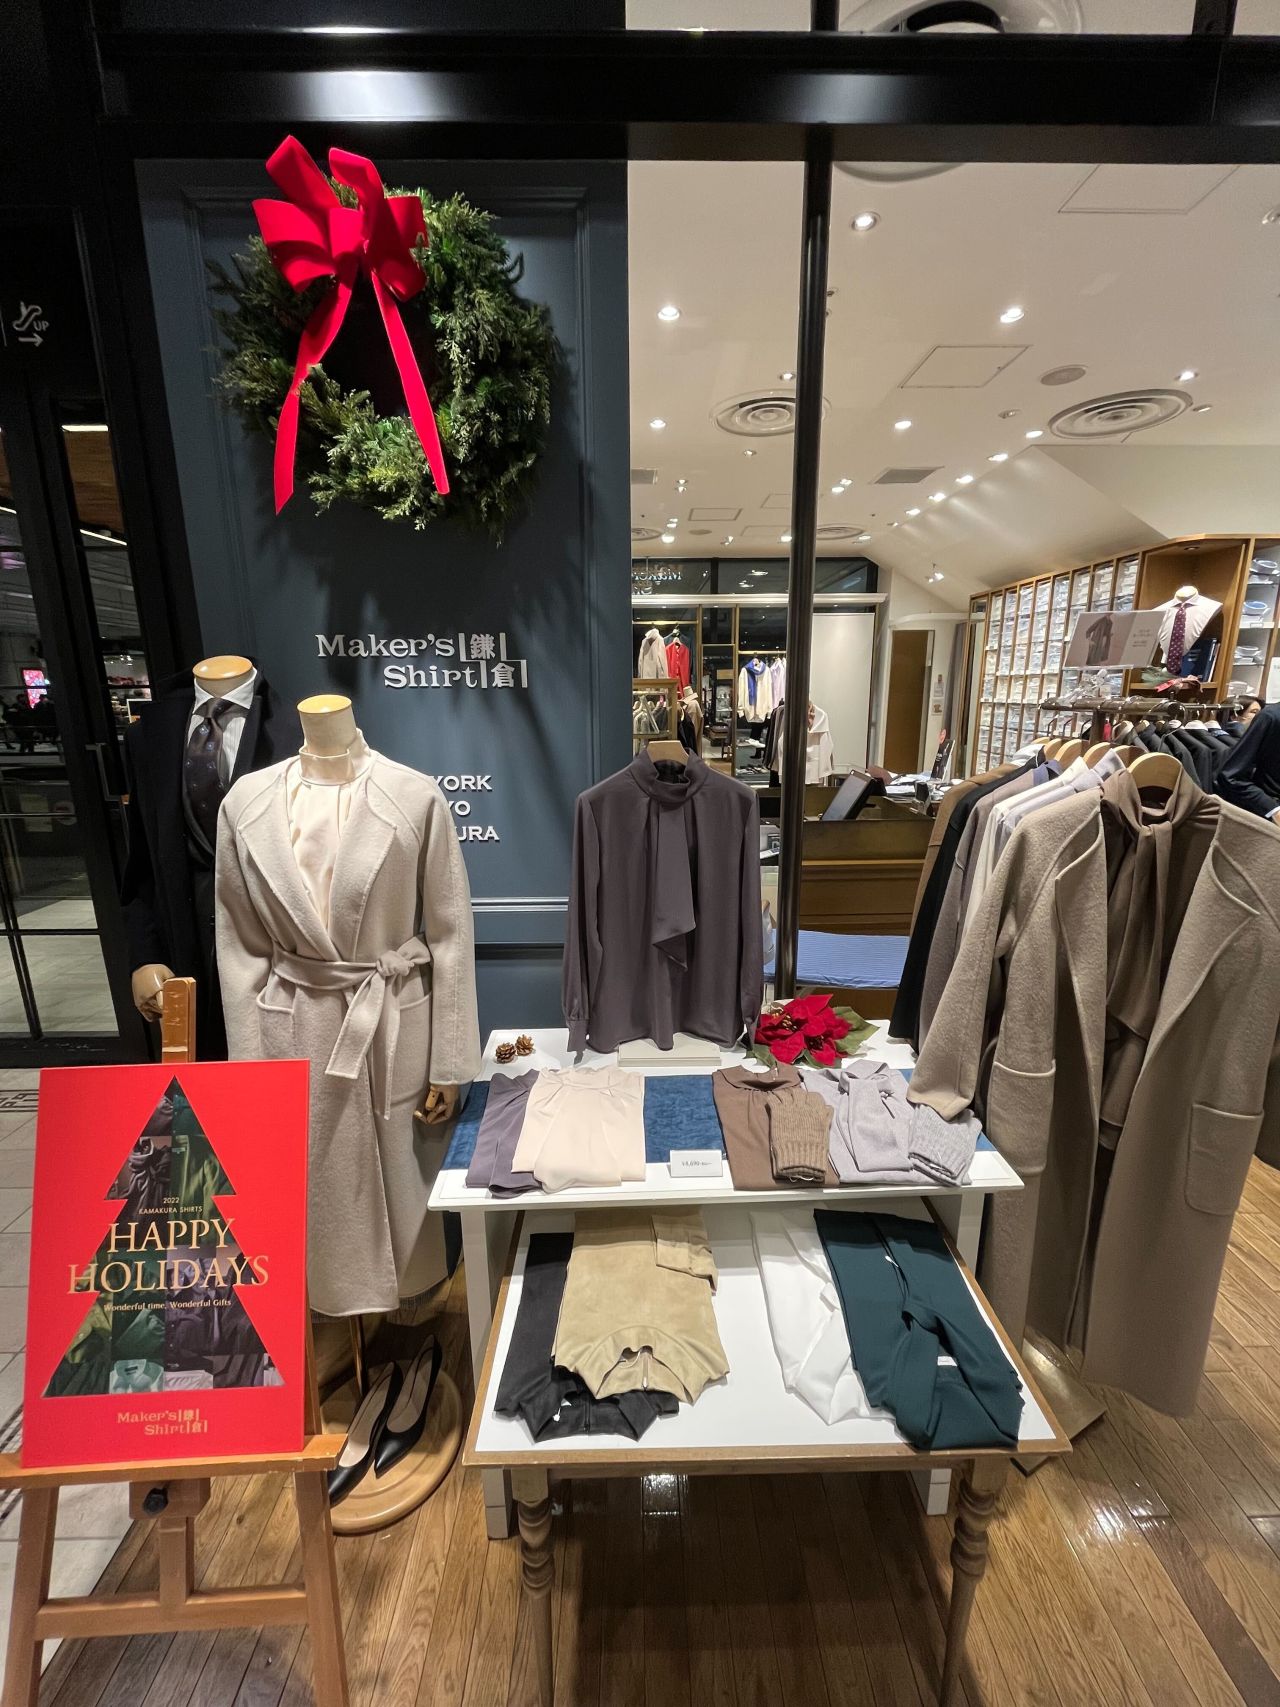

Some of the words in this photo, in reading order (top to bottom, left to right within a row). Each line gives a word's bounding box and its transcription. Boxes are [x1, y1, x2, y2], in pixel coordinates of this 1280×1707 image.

[33, 320, 49, 331] UP
[315, 633, 454, 658] Maker's
[469, 633, 496, 660] 鎌
[383, 664, 478, 688] Shirt
[490, 662, 515, 688] 倉
[138, 1207, 178, 1215] KAMAKURA
[180, 1205, 203, 1213] SHIRTS
[107, 1217, 236, 1253] HAPPY
[67, 1255, 270, 1295] HOLIDAYS
[103, 1302, 146, 1312] Wonderful
[169, 1299, 211, 1309] Wonderful
[213, 1298, 232, 1307] Gifts
[117, 1410, 177, 1423] Maker's
[144, 1423, 185, 1435] Shirt
